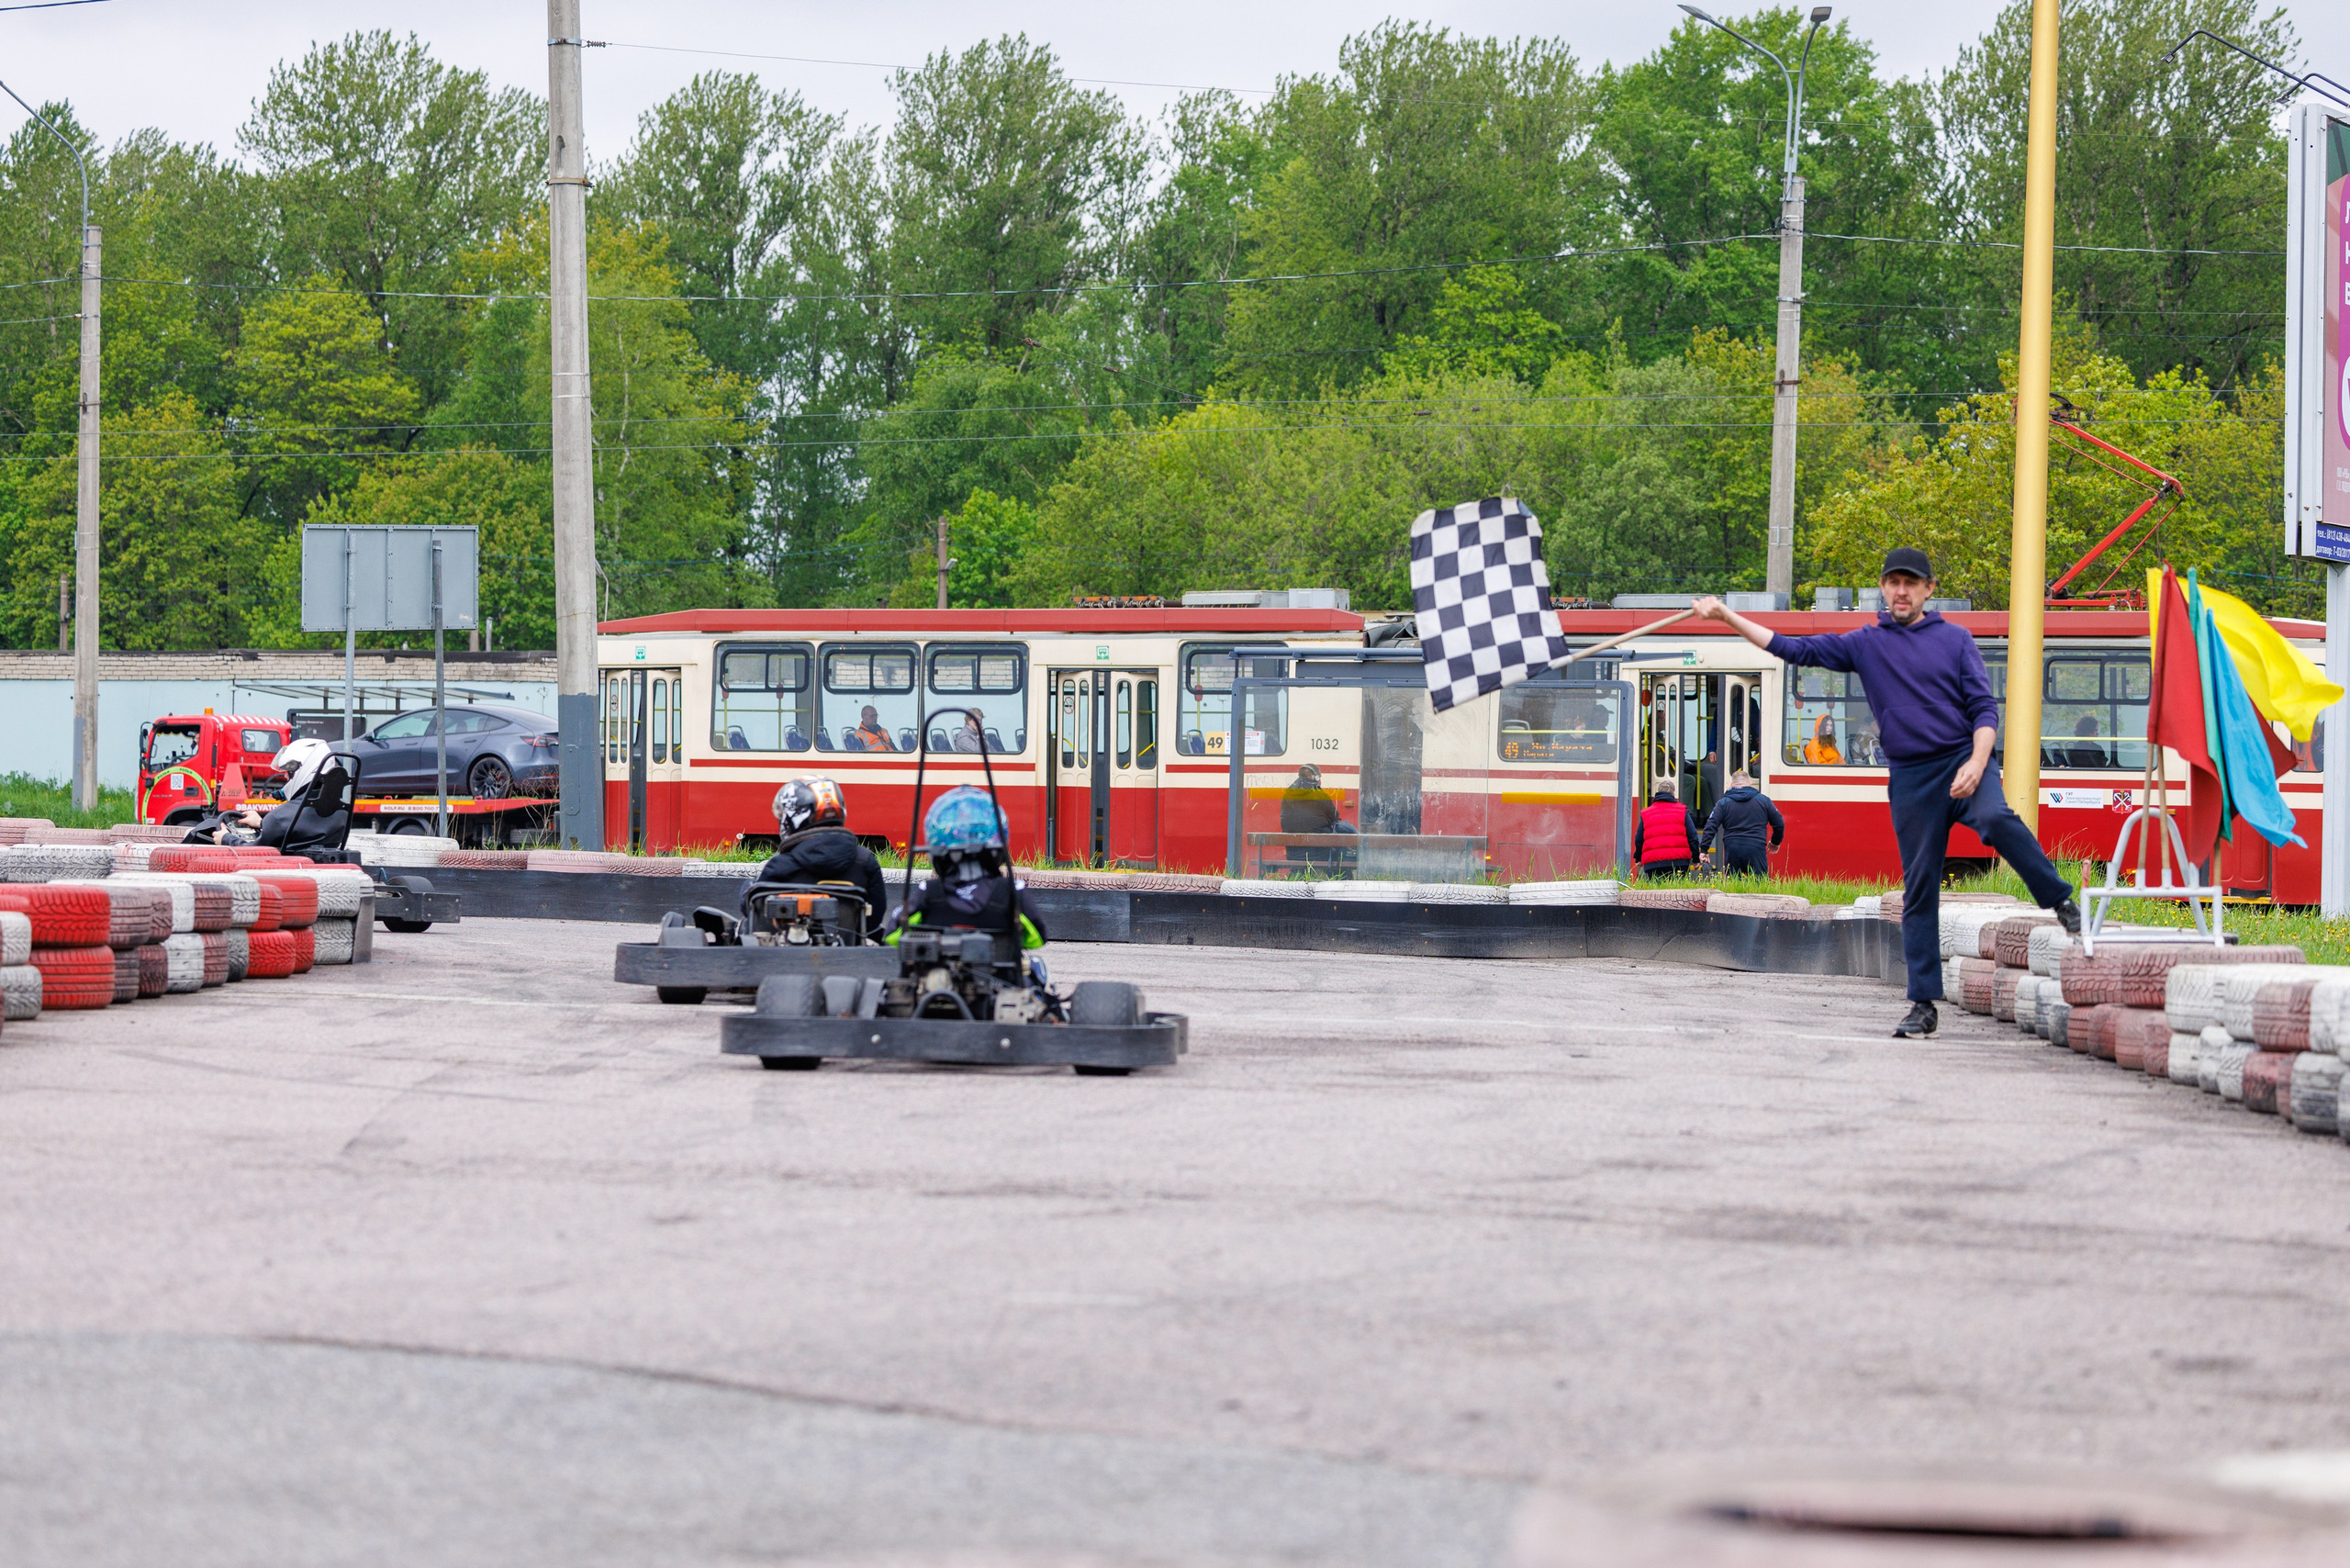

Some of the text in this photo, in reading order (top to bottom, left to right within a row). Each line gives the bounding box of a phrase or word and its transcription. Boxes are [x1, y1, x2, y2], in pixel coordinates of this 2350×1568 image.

[1207, 736, 1224, 749] 49
[1311, 738, 1339, 750] 1032
[235, 803, 280, 812] ЭВАКУАТО
